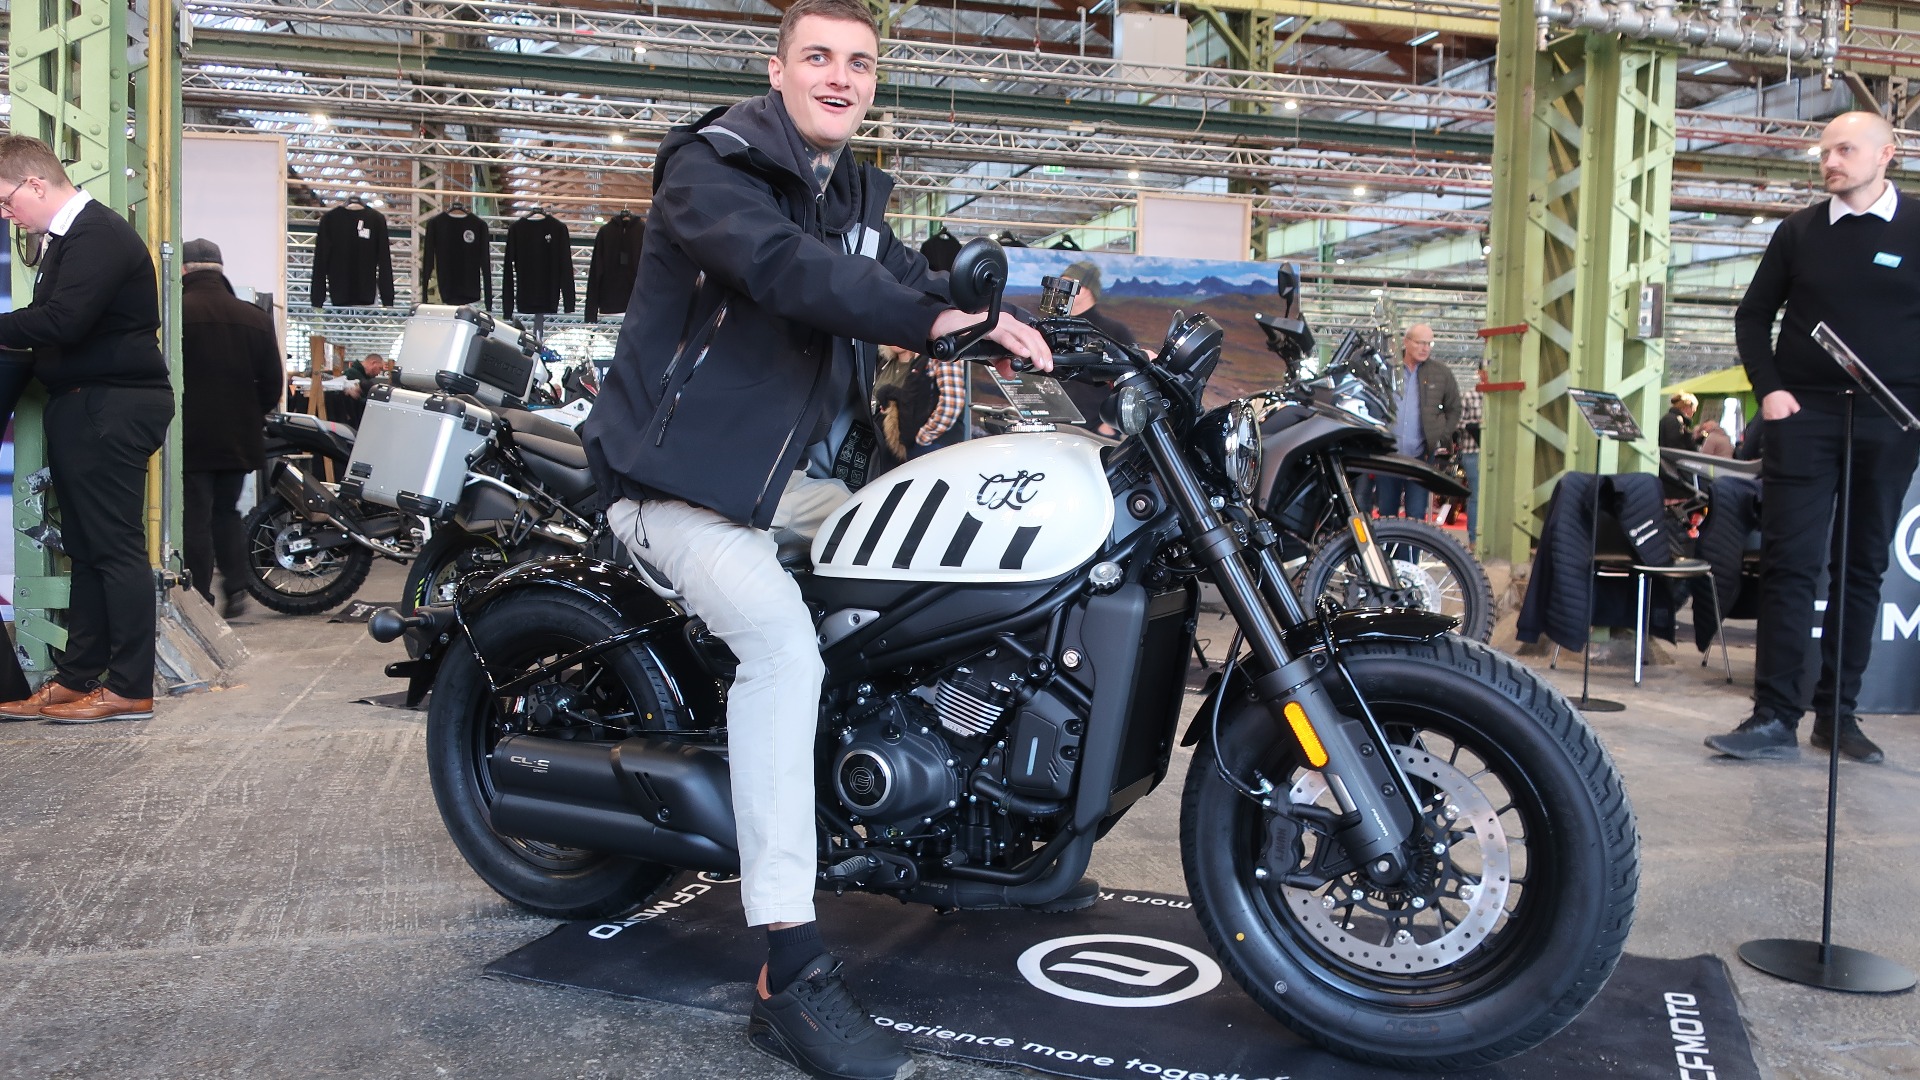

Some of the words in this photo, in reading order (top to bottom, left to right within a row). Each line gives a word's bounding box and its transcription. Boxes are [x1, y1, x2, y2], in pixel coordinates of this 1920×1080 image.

[588, 883, 712, 940] CFMOTO
[1122, 895, 1193, 910] more
[1021, 1042, 1115, 1067] more
